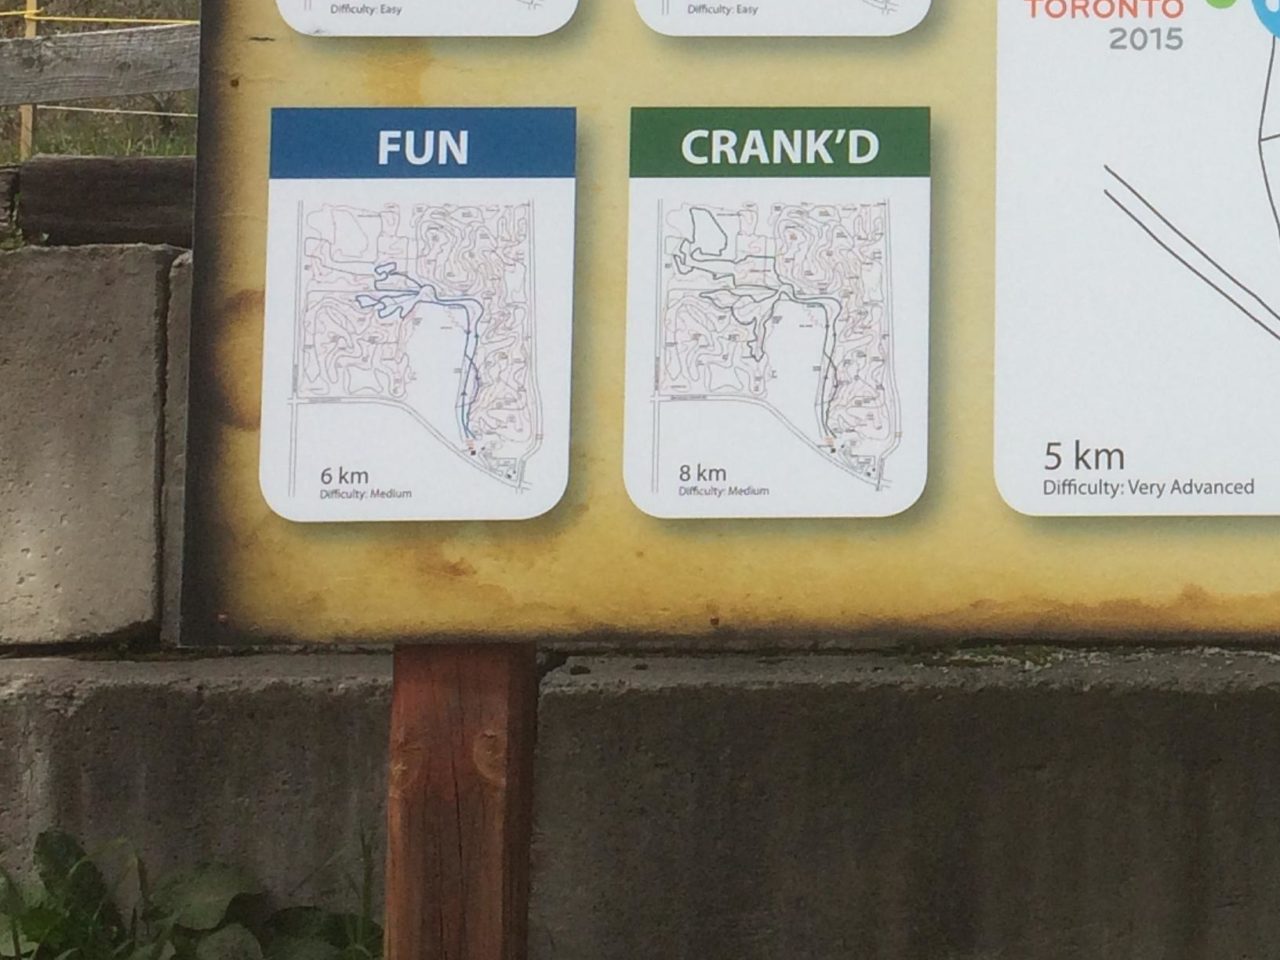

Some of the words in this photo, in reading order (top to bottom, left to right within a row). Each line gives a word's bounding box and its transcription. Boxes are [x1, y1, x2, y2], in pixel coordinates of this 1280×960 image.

[330, 4, 376, 16] Difficulty:
[380, 4, 402, 16] Easy
[687, 4, 732, 16] Difficulty:
[737, 4, 759, 16] Easy
[1109, 27, 1184, 50] 2015
[377, 129, 469, 165] FUN
[1043, 442, 1063, 470] 5
[1073, 440, 1125, 470] km
[320, 467, 332, 485] 6
[337, 466, 369, 485] km
[679, 465, 691, 482] 8
[696, 463, 727, 482] km
[319, 488, 367, 500] Difficulty:
[370, 488, 413, 499] Medium
[678, 485, 725, 498] Difficulty:
[728, 485, 770, 496] Medium
[1043, 477, 1124, 497] Difficulty:
[1129, 478, 1165, 497] Very
[1170, 477, 1255, 495] Advanced
